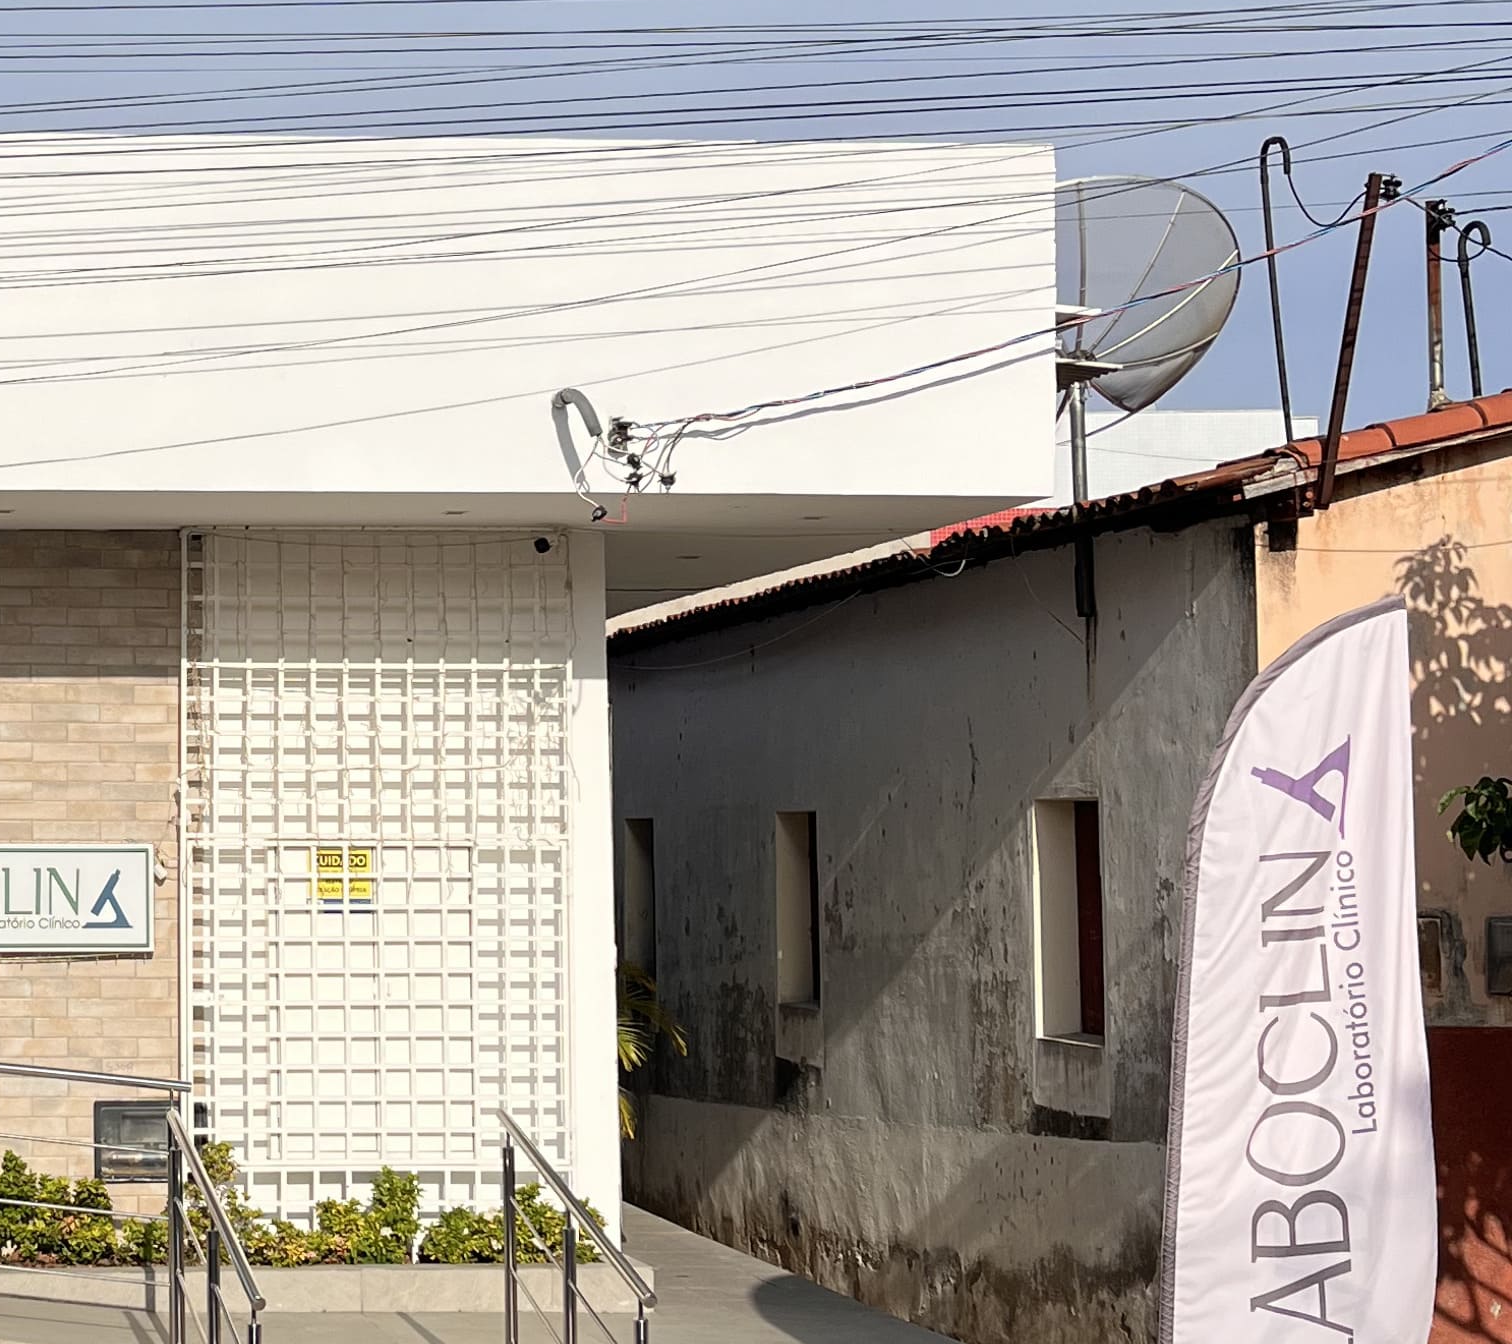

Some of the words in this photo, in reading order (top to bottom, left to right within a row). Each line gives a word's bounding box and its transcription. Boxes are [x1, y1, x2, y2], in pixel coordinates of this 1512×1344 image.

[314, 854, 366, 866] UIDDO
[38, 916, 81, 930] Clínico
[1330, 850, 1362, 952] Clínico
[1341, 961, 1378, 1135] Laboratório
